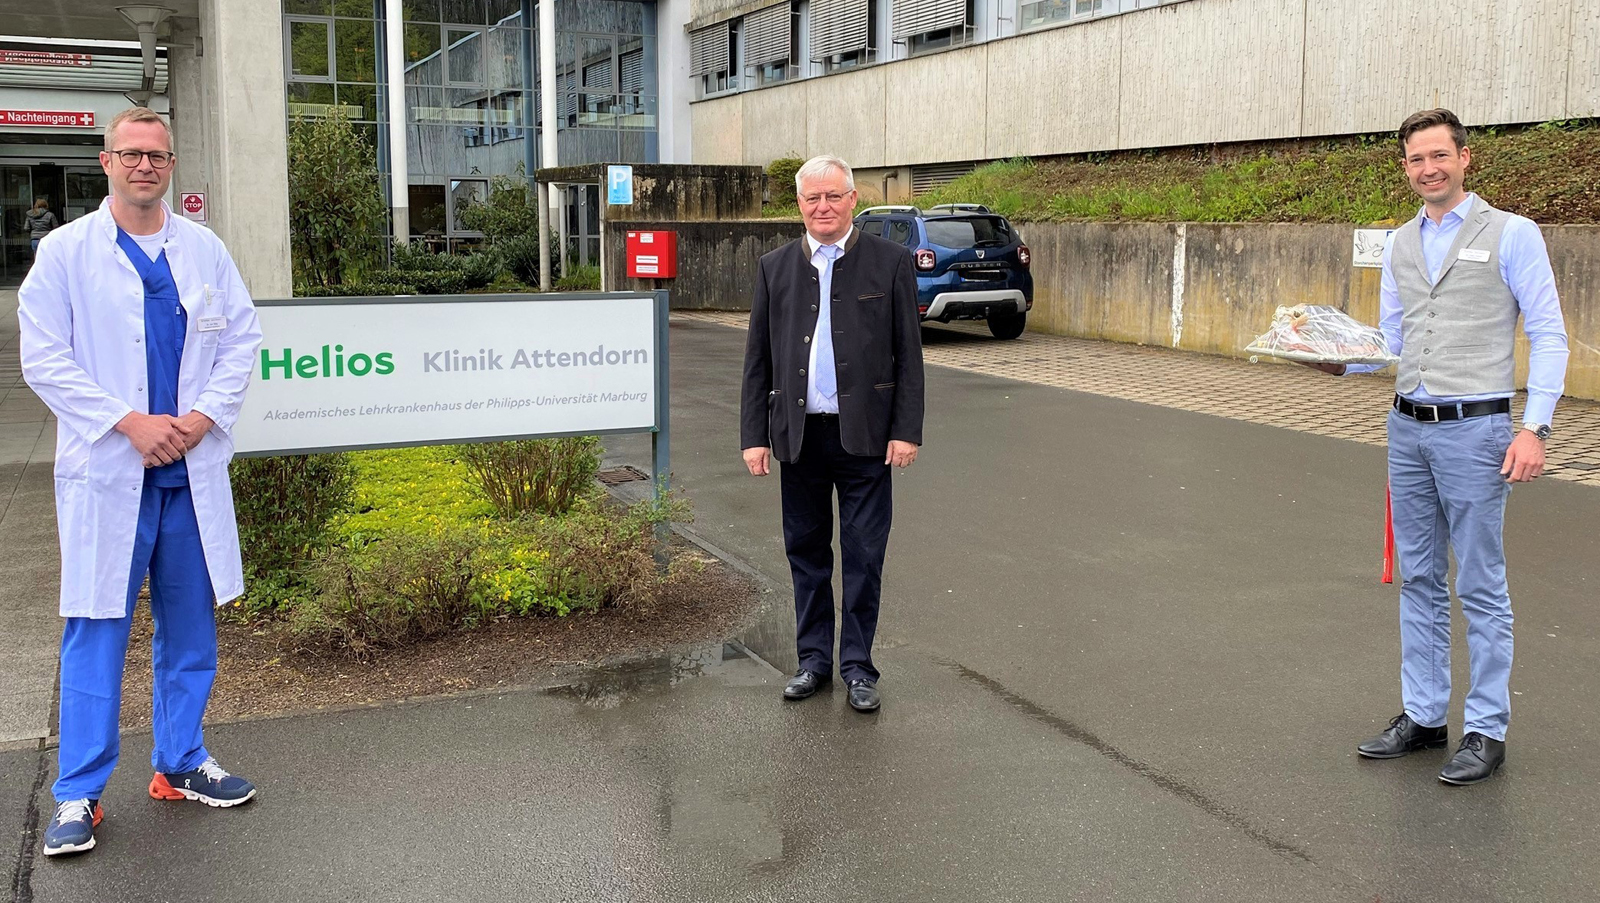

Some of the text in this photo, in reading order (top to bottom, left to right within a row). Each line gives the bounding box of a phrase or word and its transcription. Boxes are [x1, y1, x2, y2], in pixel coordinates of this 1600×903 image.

[7, 111, 76, 125] Nachteingang
[613, 168, 627, 190] P
[261, 344, 648, 380] Helios Klinik Attendorn
[263, 390, 648, 421] Akademisches Lehrkrankenhaus der Philipps-Universität Marburg
